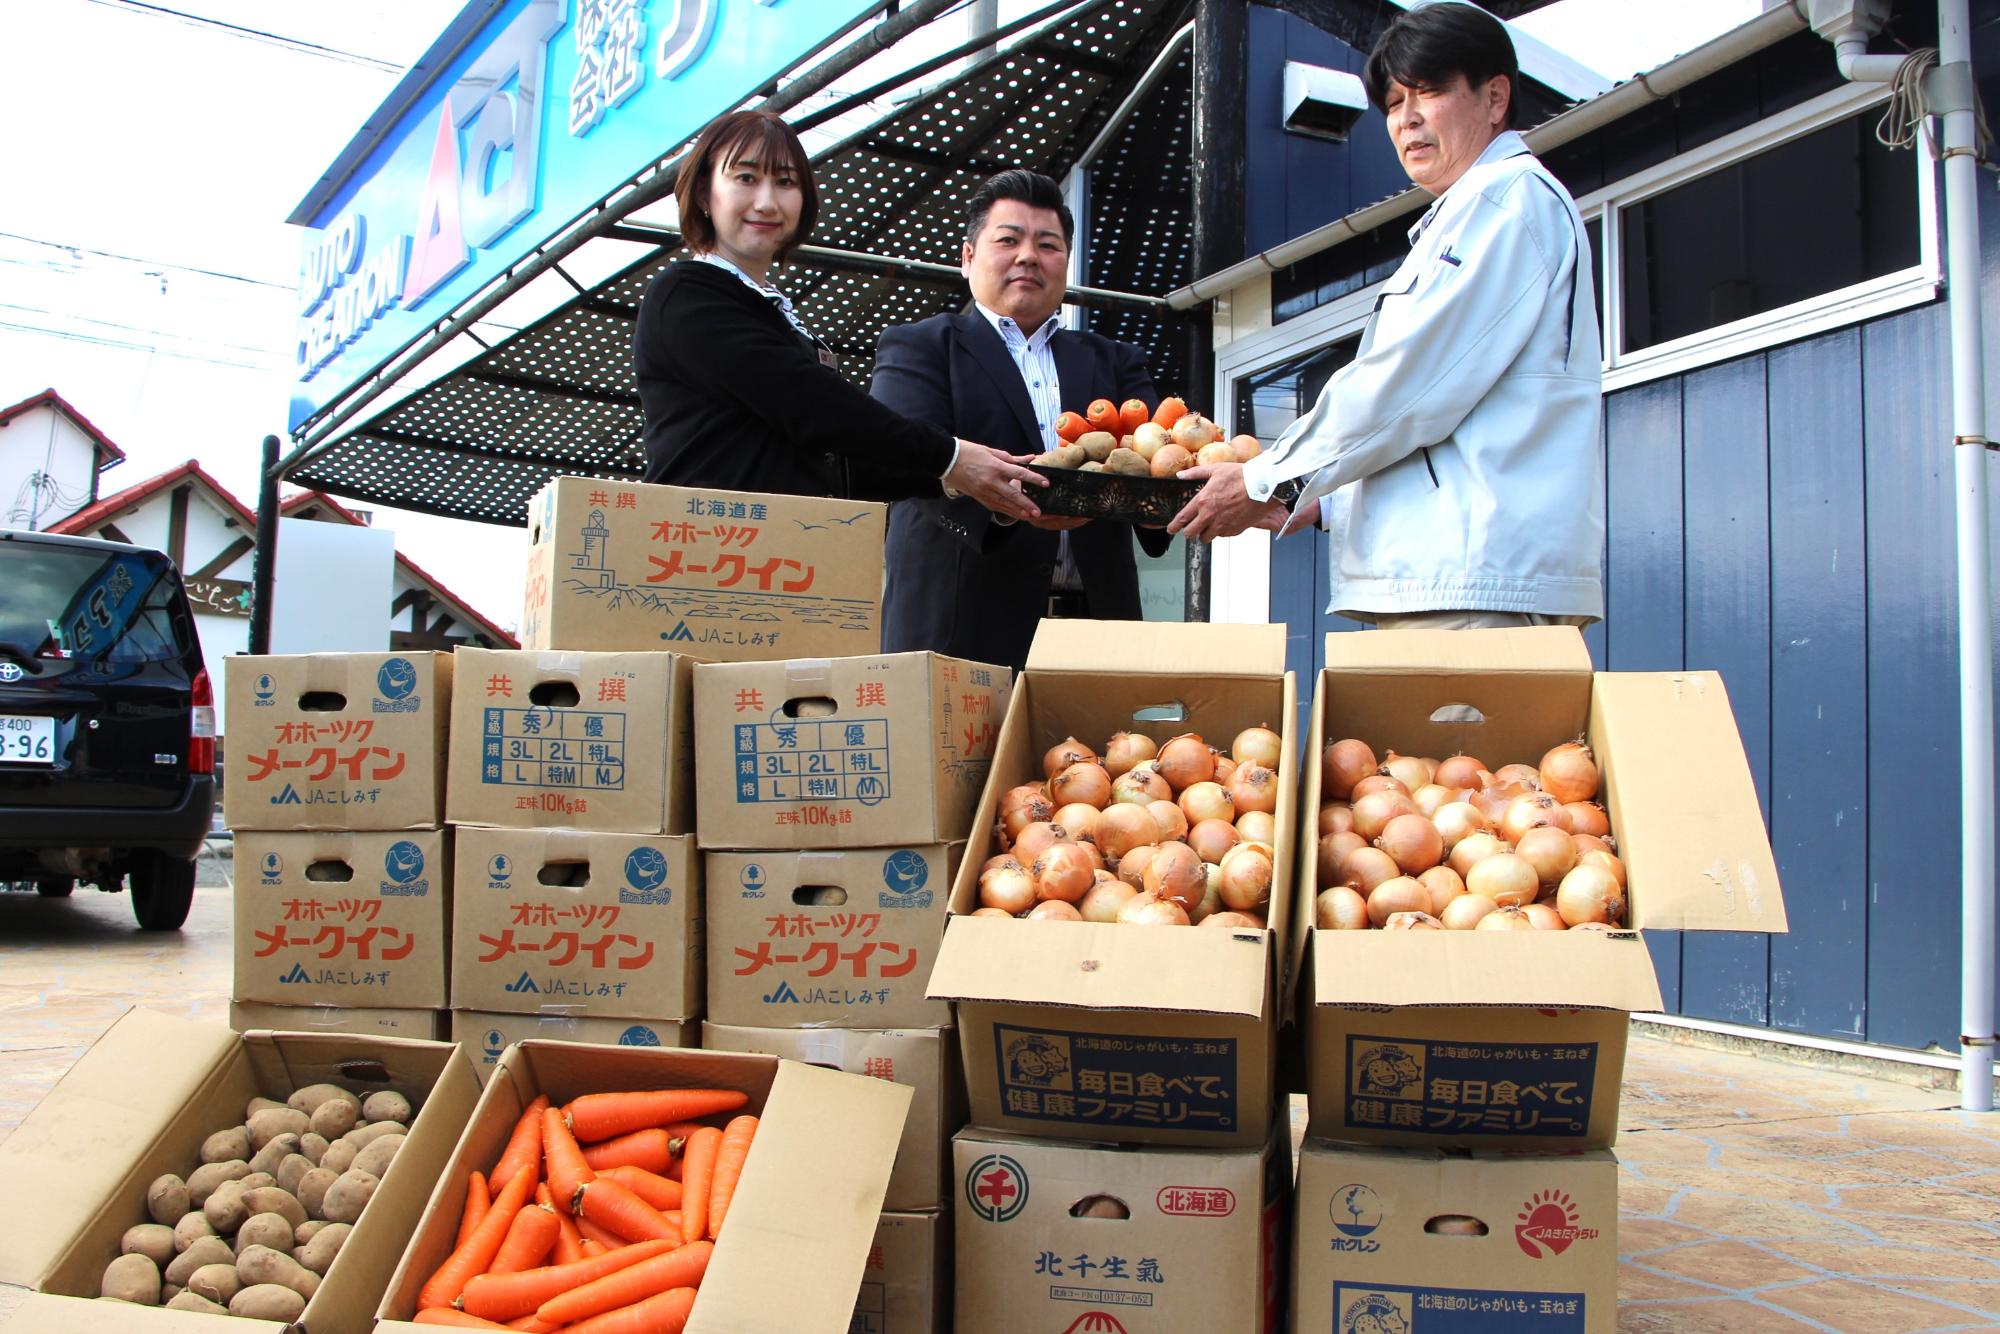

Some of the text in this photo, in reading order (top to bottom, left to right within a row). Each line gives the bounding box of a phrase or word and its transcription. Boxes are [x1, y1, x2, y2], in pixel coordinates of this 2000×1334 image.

[589, 491, 609, 508] 共
[687, 498, 768, 520] 北海道産
[650, 520, 759, 548] オホーツク
[646, 550, 815, 592] メークイン
[699, 627, 780, 647] JAこしみず
[486, 674, 626, 702] 共 撰
[734, 682, 886, 712] 共 撰
[7, 719, 32, 731] 400
[274, 720, 374, 744] オホーツク
[523, 714, 604, 737] 秀 優
[777, 724, 866, 748] 秀 優
[510, 740, 620, 763] 3L 2L 特L
[766, 752, 881, 774] 3L 2L 特L
[247, 747, 405, 781] メークイン
[515, 764, 527, 781] L
[548, 766, 576, 784] 特M
[305, 788, 381, 804] JAこしみず
[773, 776, 876, 798] L 特M M
[281, 899, 382, 922] オホーツク
[510, 902, 620, 929] オホーツク
[765, 913, 881, 938] オホーツク
[254, 925, 414, 960] メークイン
[478, 929, 654, 970] メークイン
[734, 942, 918, 978] メークイン
[315, 970, 391, 986] JAこしみず
[543, 979, 628, 998] JAこしみず
[803, 987, 890, 1005] JAこしみず
[1075, 1037, 1231, 1055] 北海道のじゃがいも・玉ねぎ
[1432, 1046, 1591, 1061] 北海道のじゃがいも・玉ねぎ
[1078, 1068, 1230, 1099] 毎日食べて、
[1429, 1078, 1585, 1106] 毎日食べて、
[1006, 1088, 1232, 1126] 健康ファミリー。
[1351, 1099, 1583, 1132] 健康ファミリー。
[1165, 1191, 1228, 1212] 北海道
[1331, 1237, 1380, 1252] ホクレン
[1035, 1251, 1165, 1283] 北千生氣
[1418, 1294, 1578, 1315] 北海道のじゃがいも・玉ねぎ
